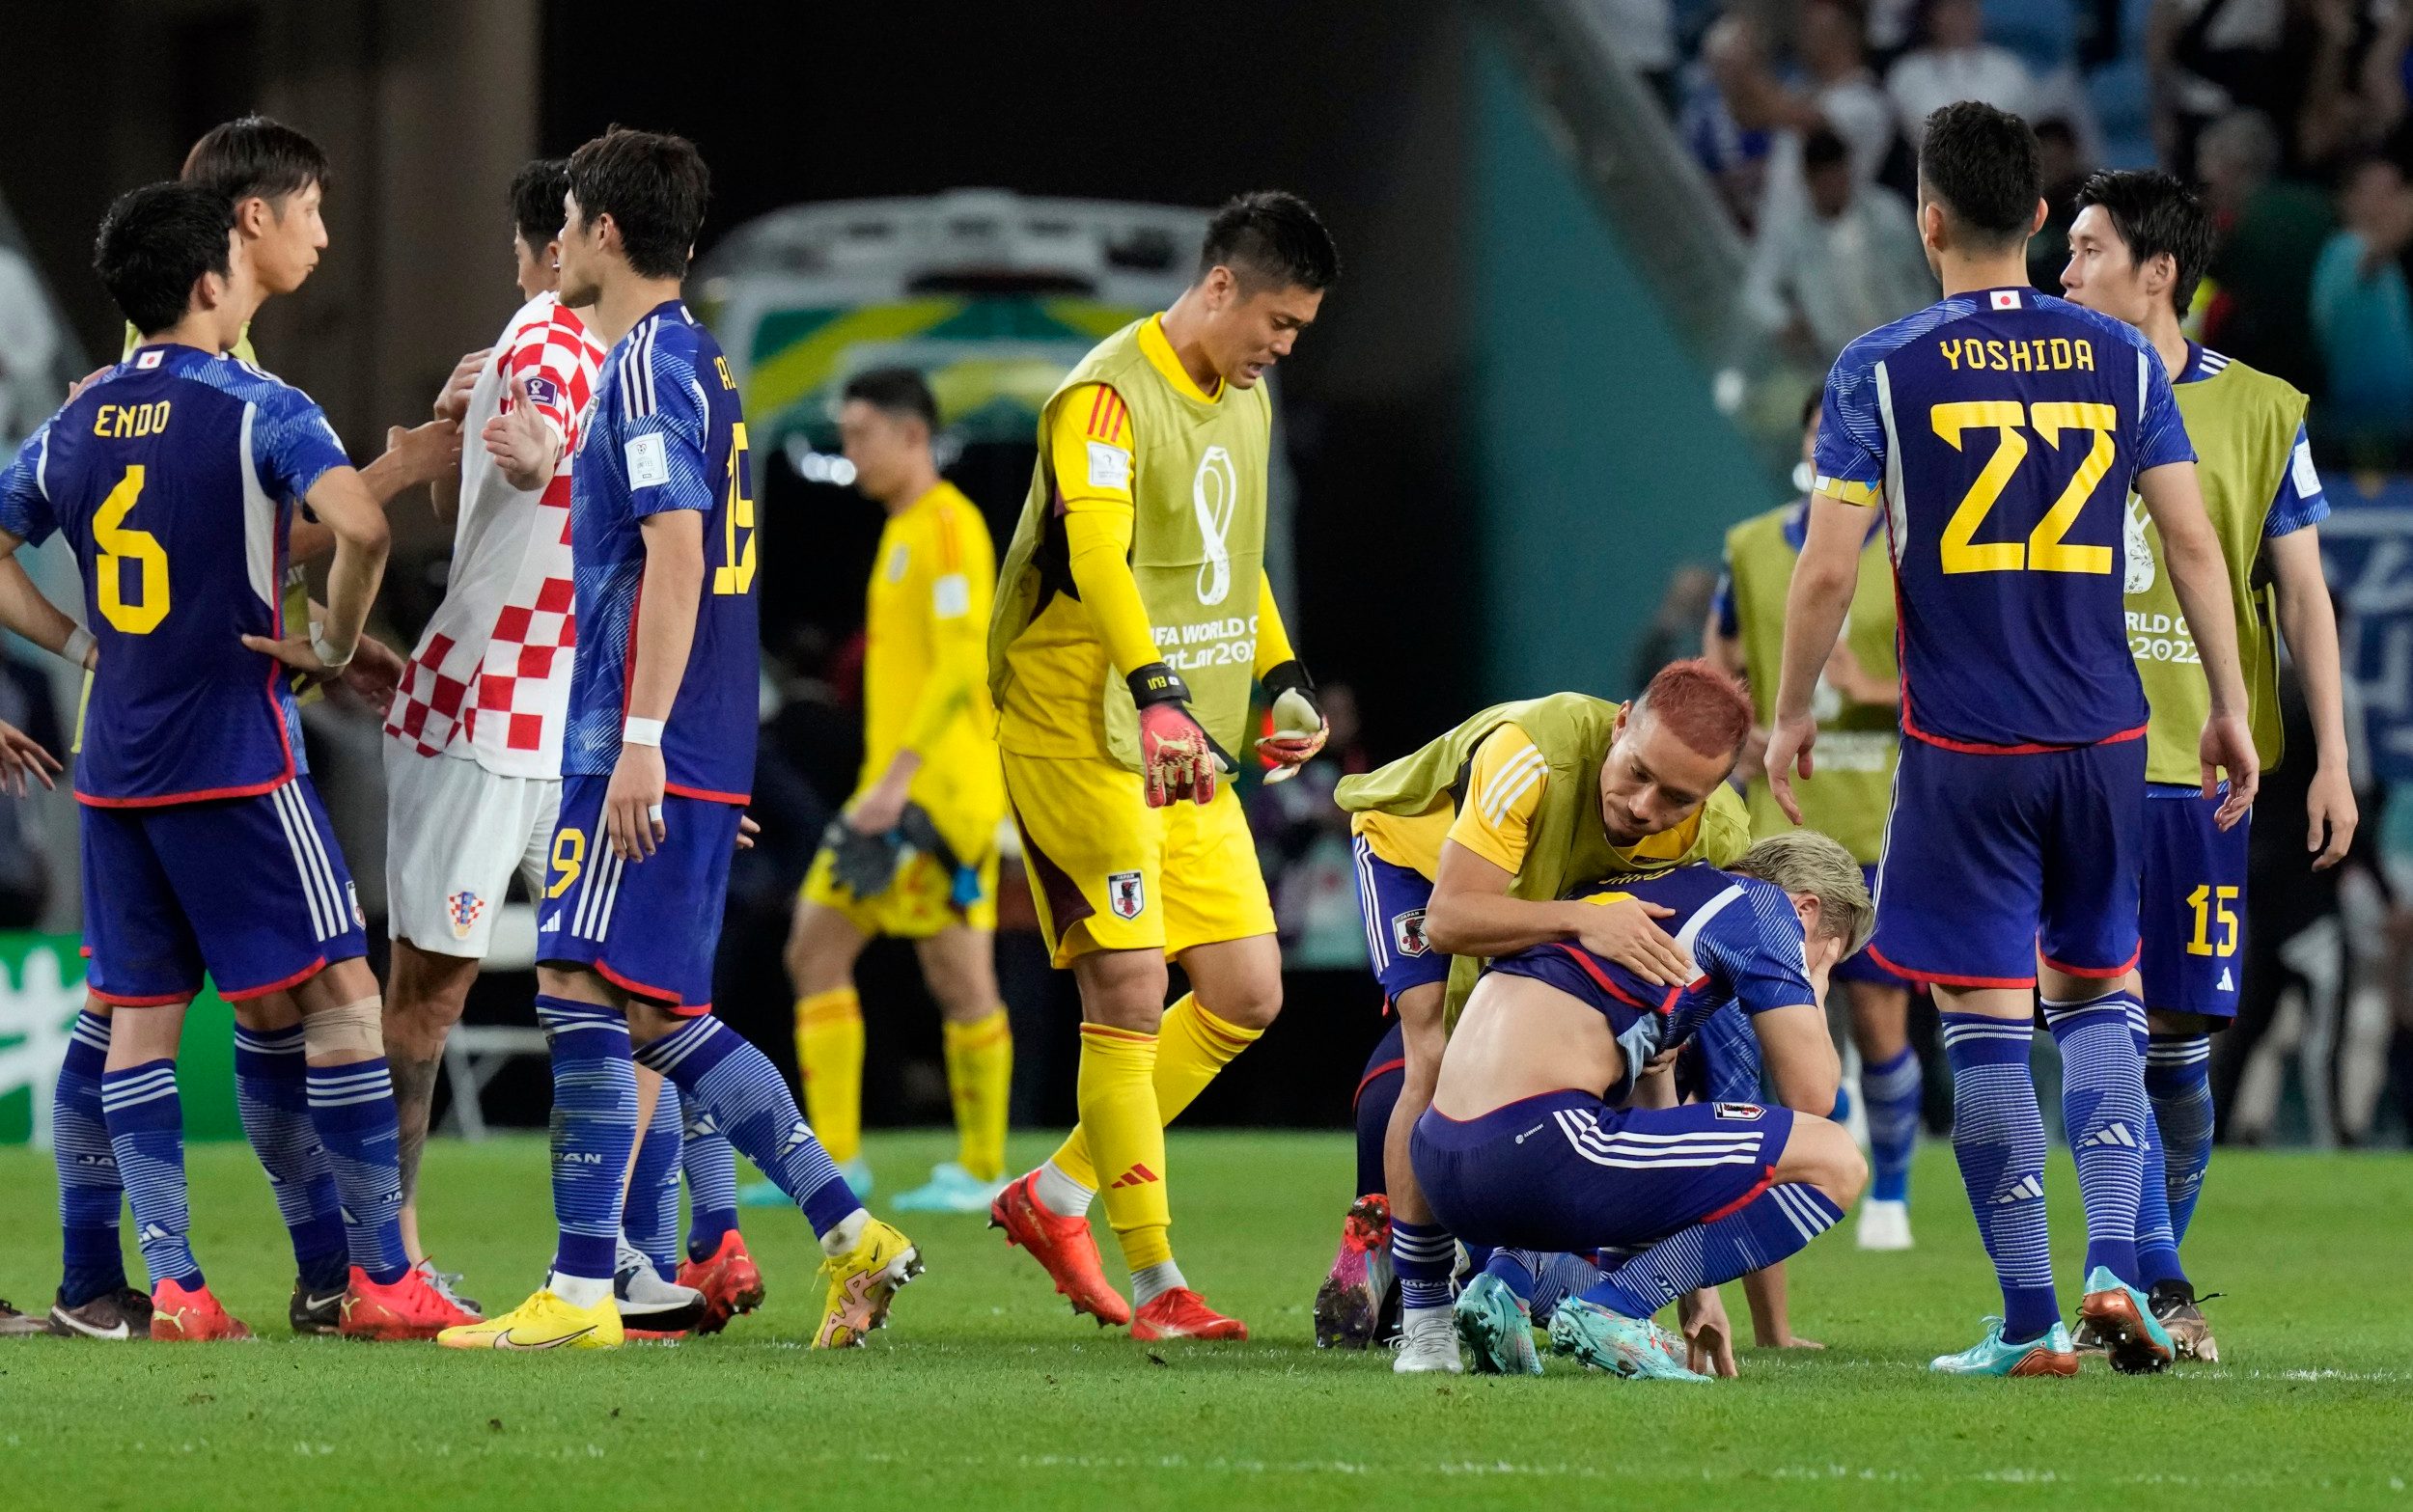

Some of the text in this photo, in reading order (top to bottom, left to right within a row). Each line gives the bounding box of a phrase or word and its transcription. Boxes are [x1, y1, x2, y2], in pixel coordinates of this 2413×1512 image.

[1939, 339, 2094, 372] YOSHIDA
[94, 399, 172, 438] ENDO
[1930, 400, 2117, 575] 22
[93, 464, 171, 635] 6
[1182, 618, 1245, 645] WORLD
[2127, 636, 2202, 665] 2022
[541, 827, 586, 898] 9
[1400, 911, 1420, 920] JAPAN
[2185, 884, 2239, 957] 15
